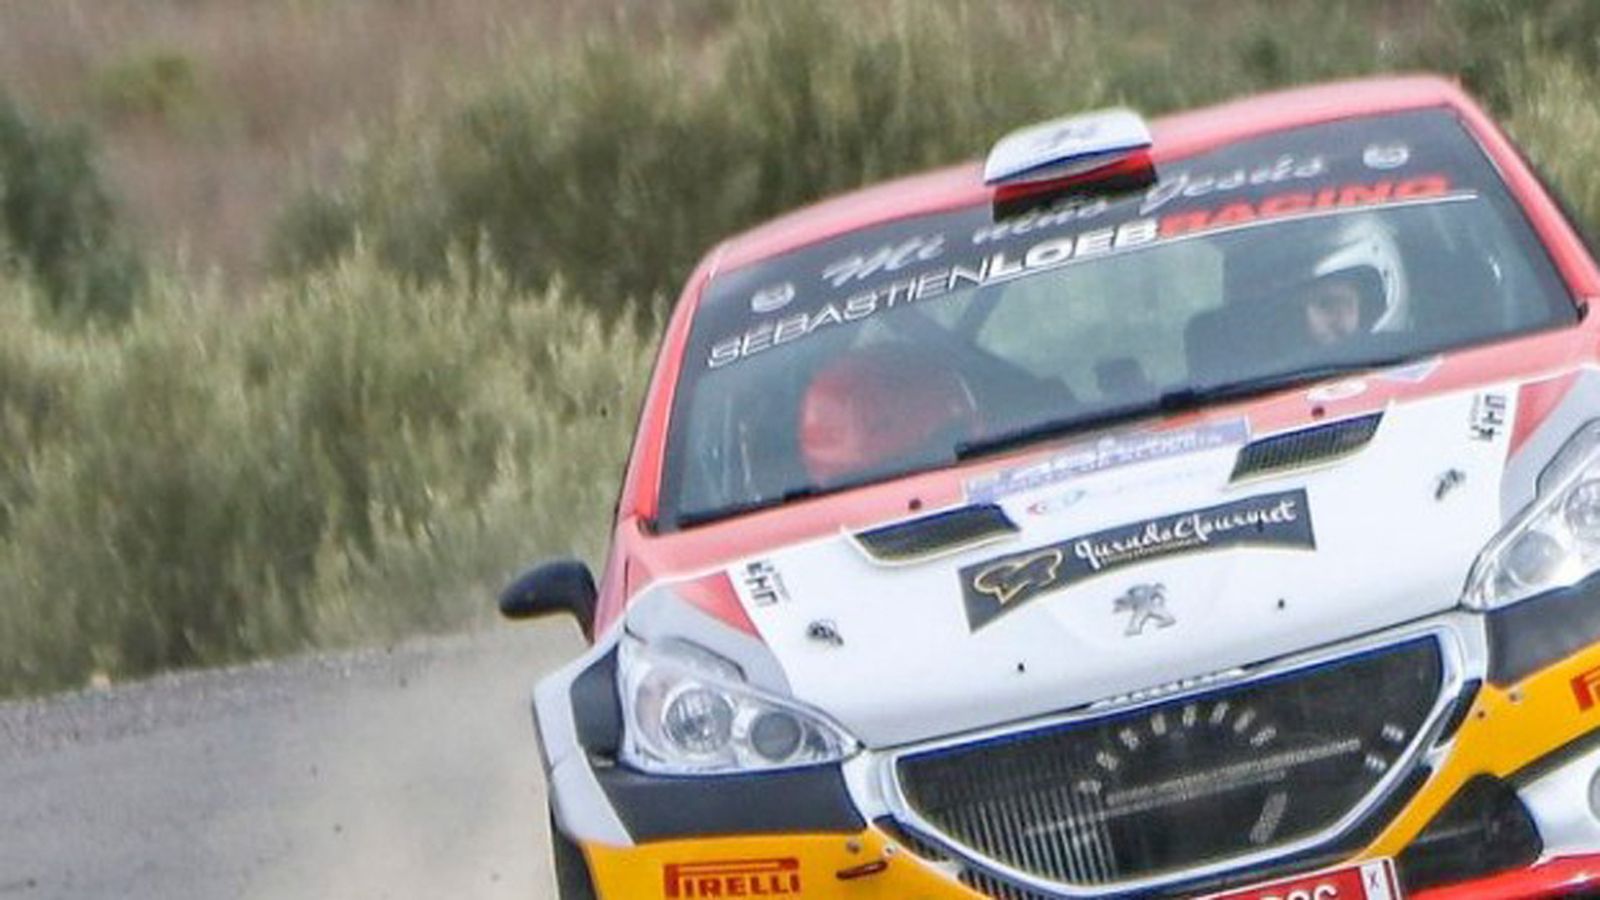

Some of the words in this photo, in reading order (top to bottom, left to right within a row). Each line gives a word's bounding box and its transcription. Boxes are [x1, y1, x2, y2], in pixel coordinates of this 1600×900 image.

[985, 217, 1159, 281] LOEB
[1157, 172, 1452, 240] RACING
[663, 856, 801, 899] PIRELLI
